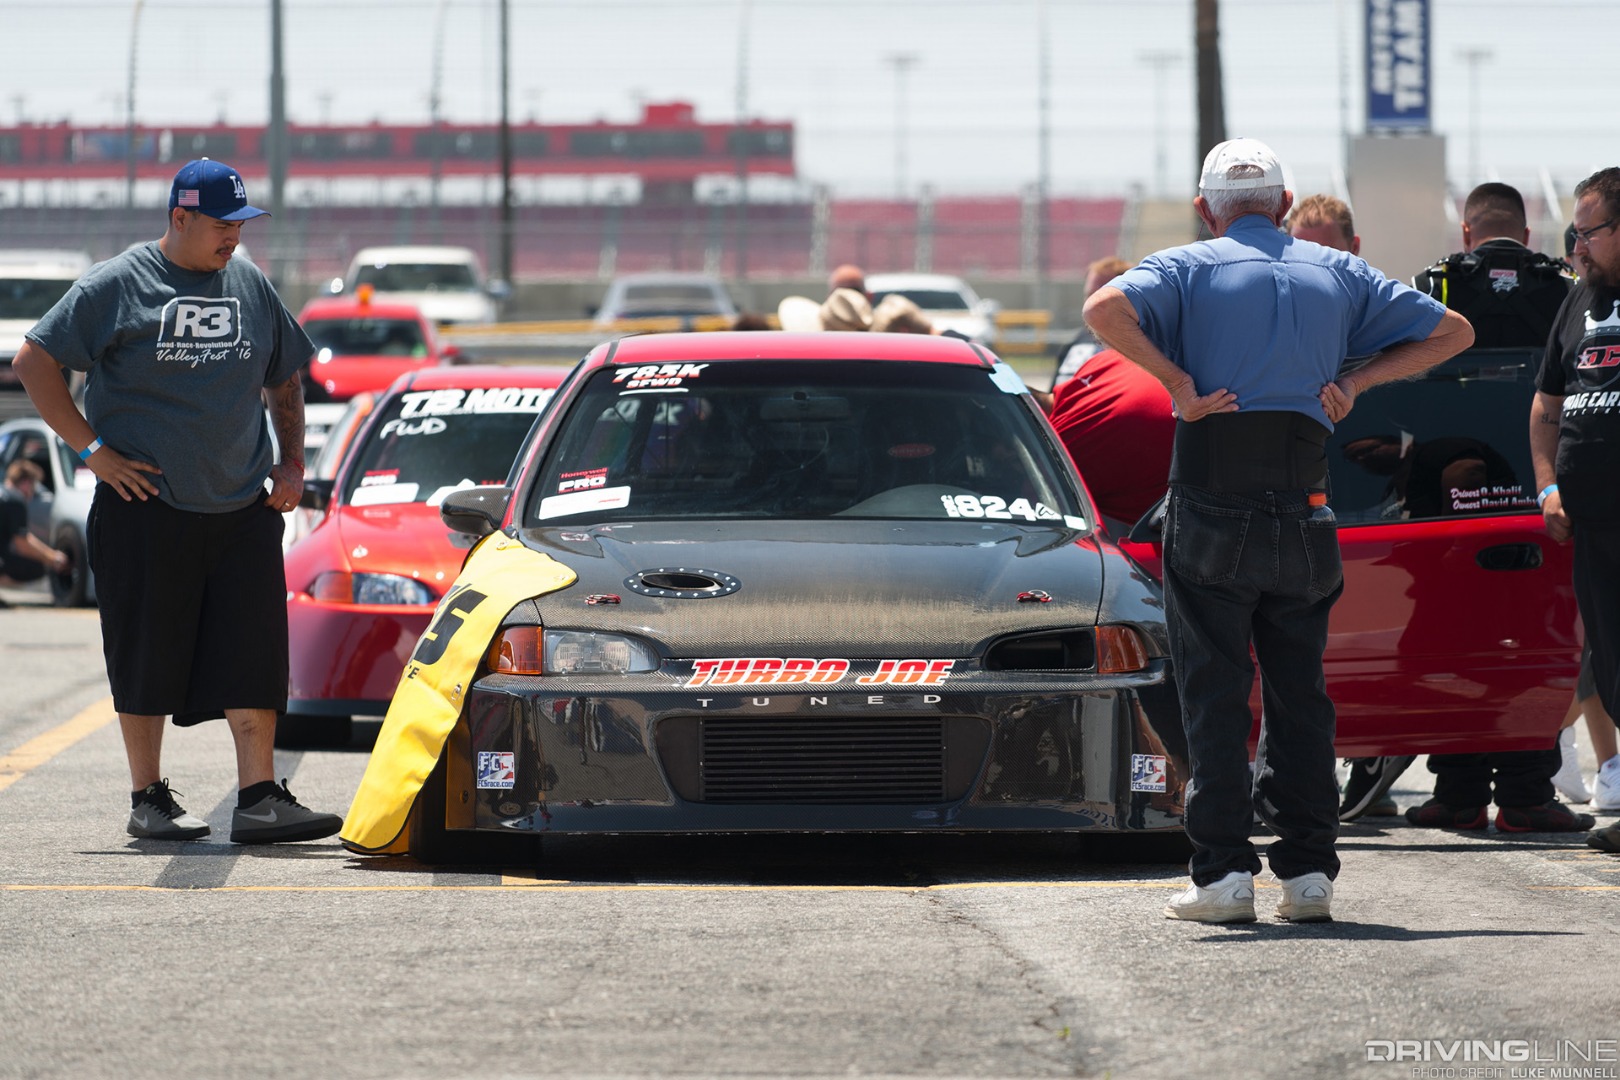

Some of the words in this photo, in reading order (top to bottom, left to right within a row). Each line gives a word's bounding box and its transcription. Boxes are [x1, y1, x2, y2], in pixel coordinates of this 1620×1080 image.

[229, 175, 246, 199] LA
[173, 304, 232, 338] R3
[612, 363, 710, 384] 785K
[1587, 391, 1620, 408] CAR
[379, 417, 447, 440] FWD
[559, 476, 606, 491] PRO
[684, 658, 850, 688] TURBO
[855, 660, 955, 686] JOE
